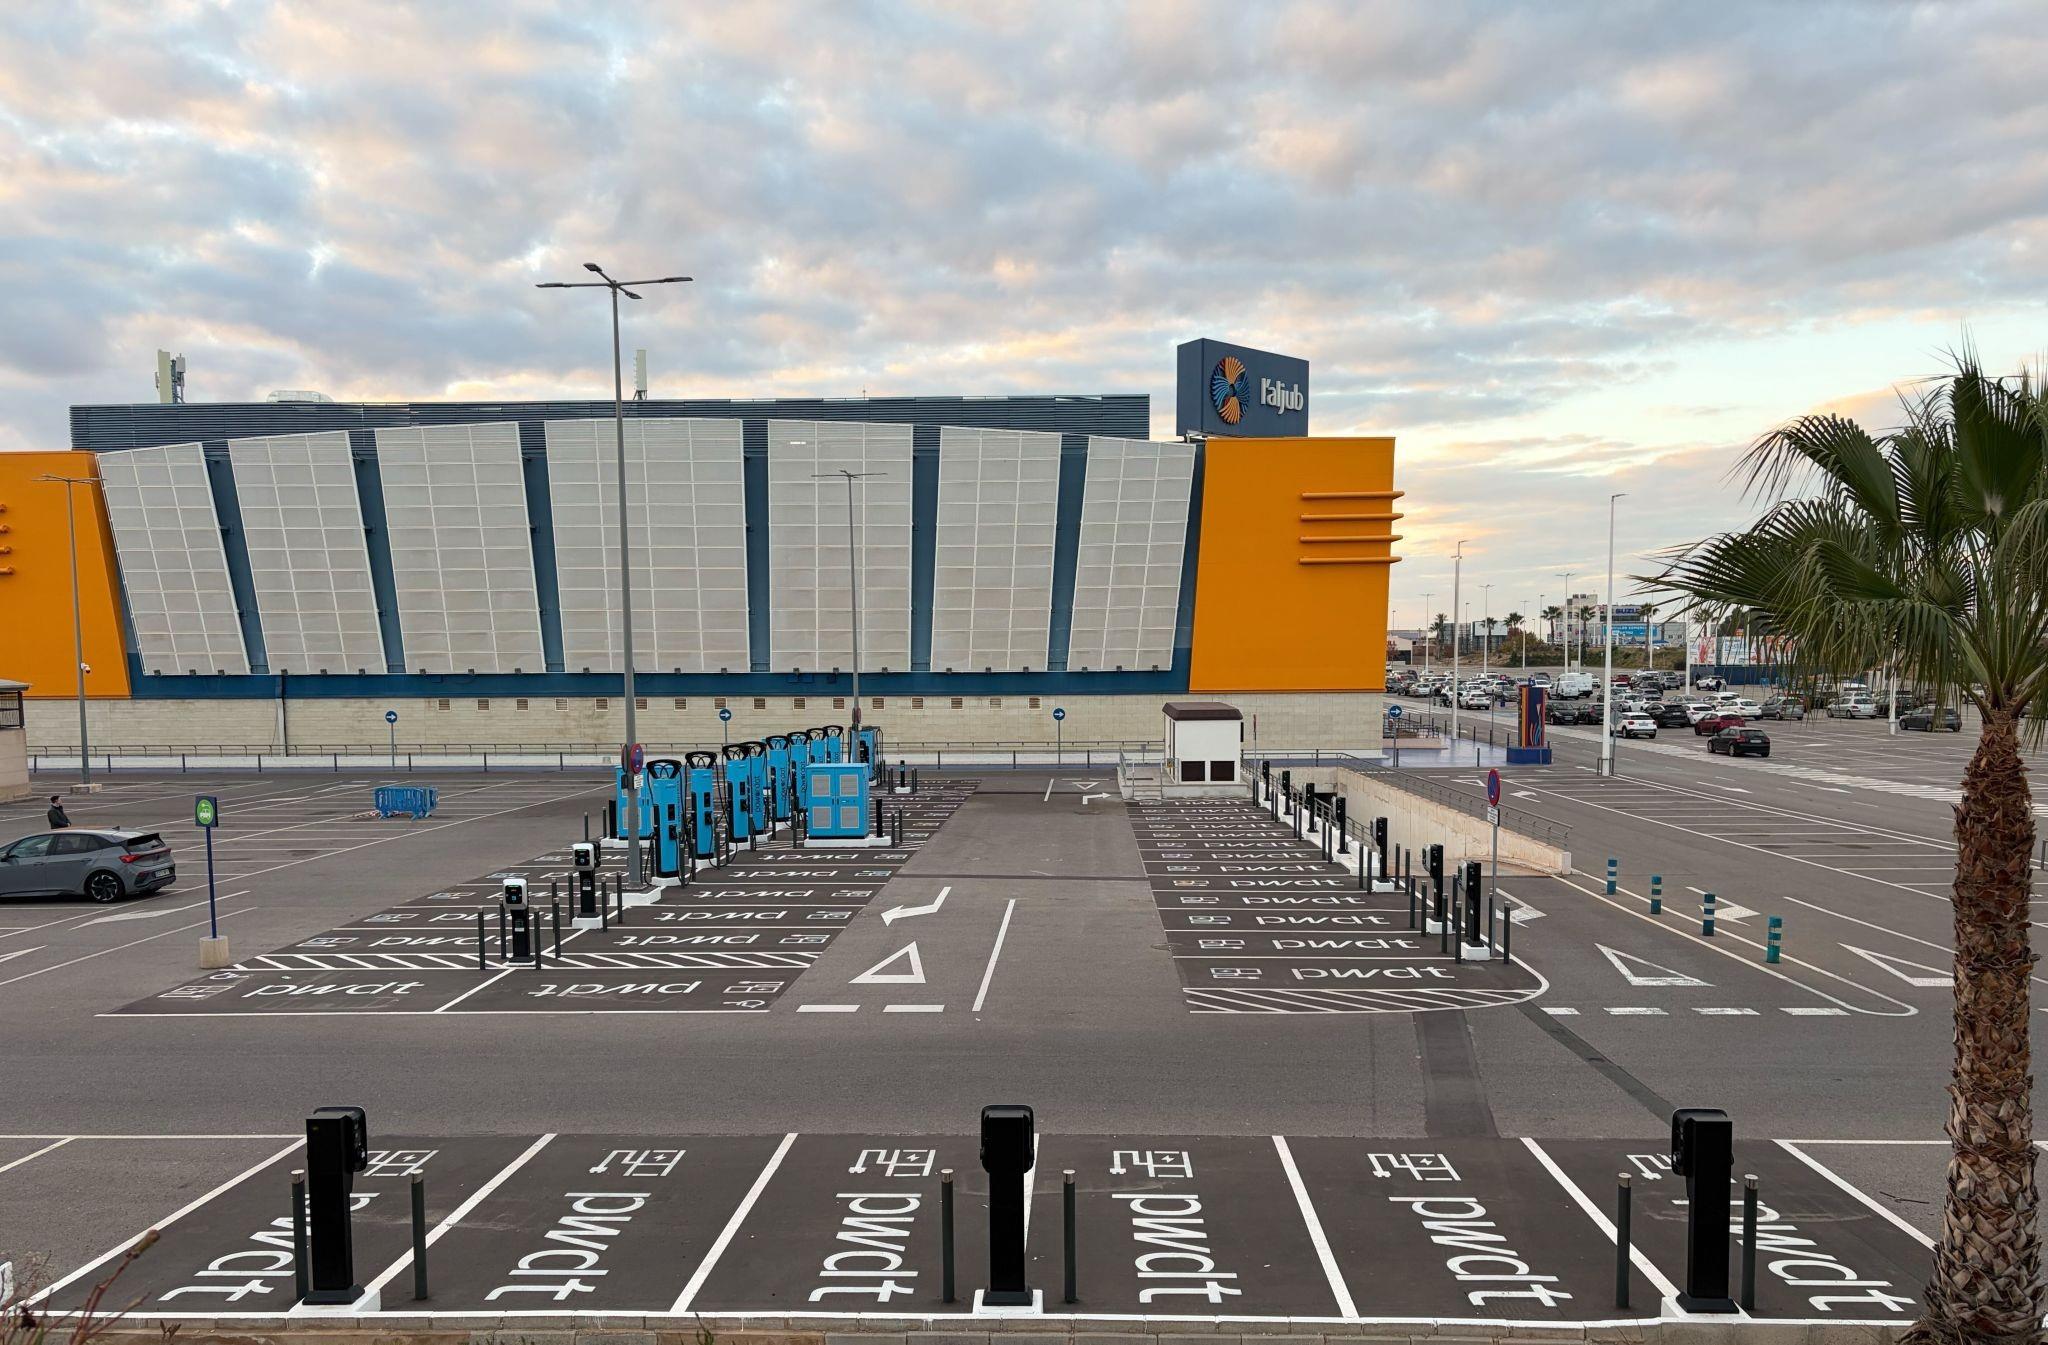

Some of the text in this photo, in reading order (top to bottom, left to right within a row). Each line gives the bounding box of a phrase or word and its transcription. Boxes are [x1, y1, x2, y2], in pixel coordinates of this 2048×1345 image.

[1260, 378, 1304, 415] l'aljub
[1230, 879, 1344, 887] pwdt
[693, 890, 814, 898] pwdt
[1241, 896, 1366, 905] pwdt
[654, 911, 788, 921] pwdt
[1255, 915, 1391, 925] pwdt
[614, 935, 760, 946] pwdt
[1271, 938, 1420, 950] pwdt
[1291, 966, 1455, 980] pwdt
[242, 981, 425, 998] pwdt
[528, 981, 702, 997] pwdt
[484, 1192, 652, 1301] pwdt
[808, 1193, 922, 1302] pwdt
[1111, 1193, 1243, 1303] pwdt
[1388, 1197, 1574, 1308] pwdt
